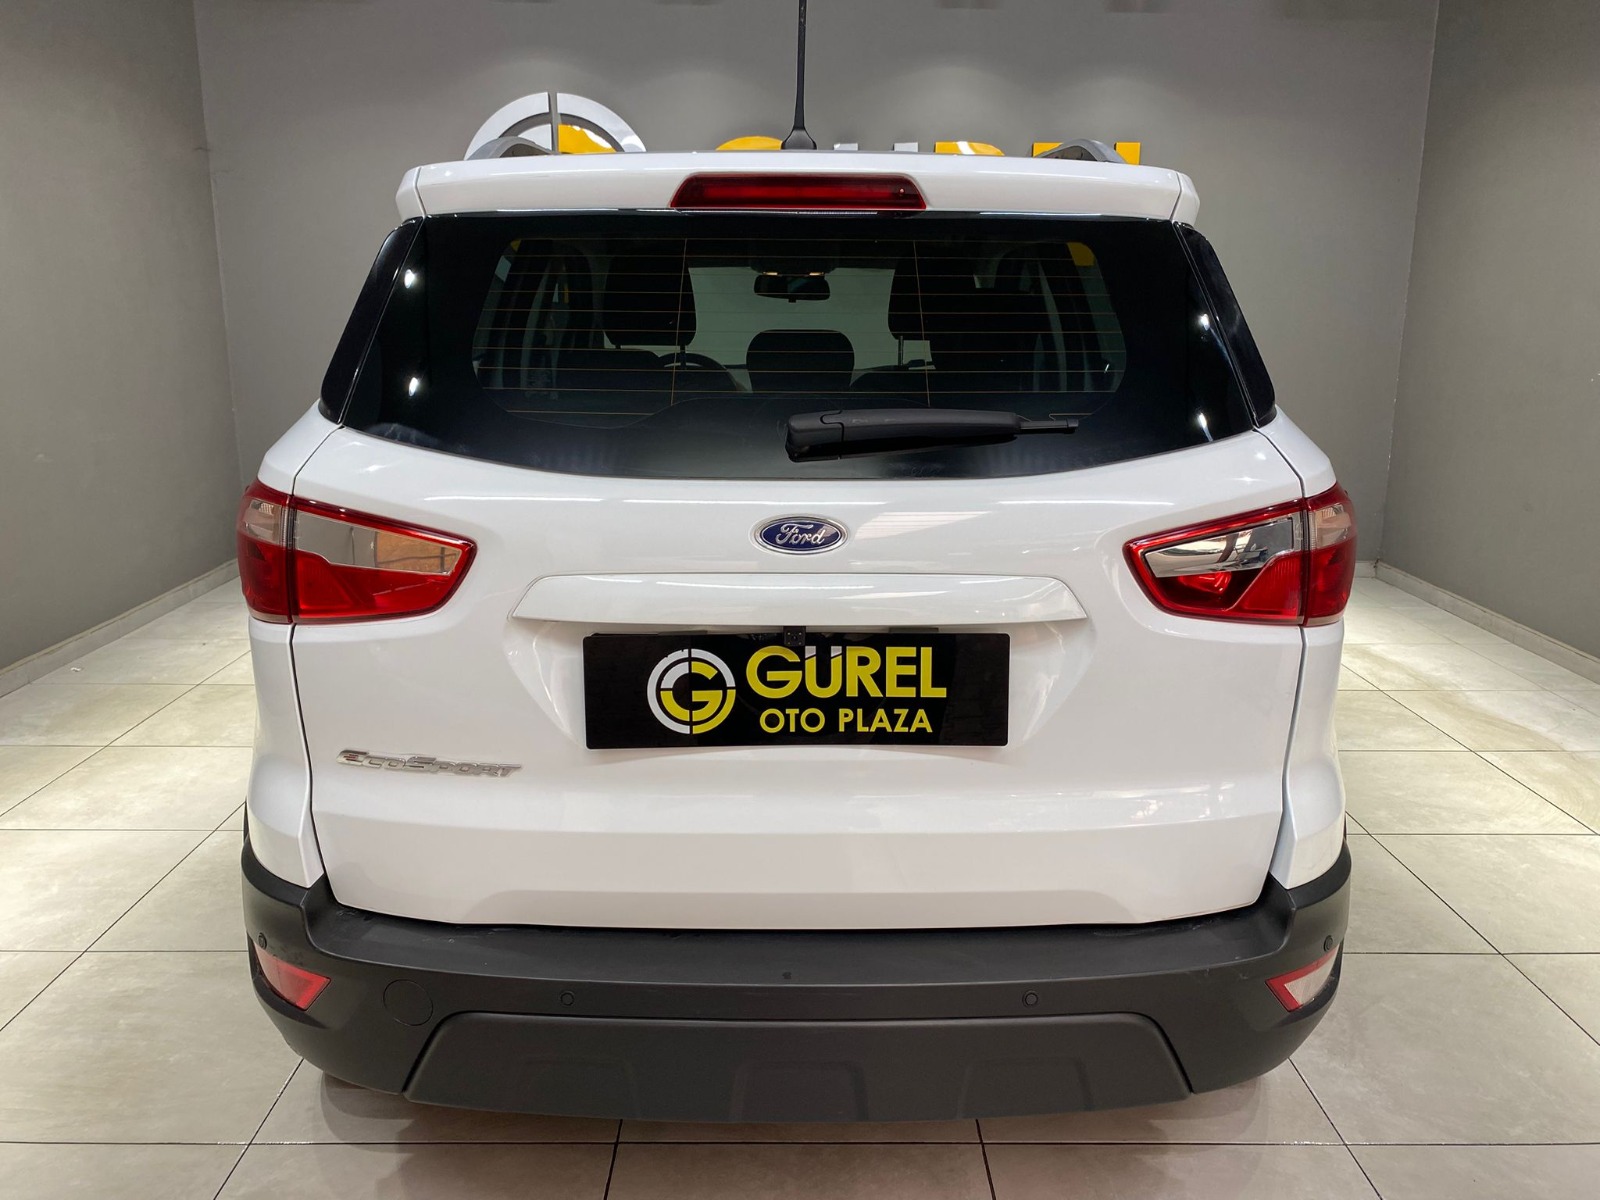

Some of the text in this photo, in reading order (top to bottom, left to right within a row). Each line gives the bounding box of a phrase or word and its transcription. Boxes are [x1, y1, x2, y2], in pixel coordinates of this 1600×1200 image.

[775, 523, 825, 545] Ford
[759, 707, 933, 734] OTO PLAZA
